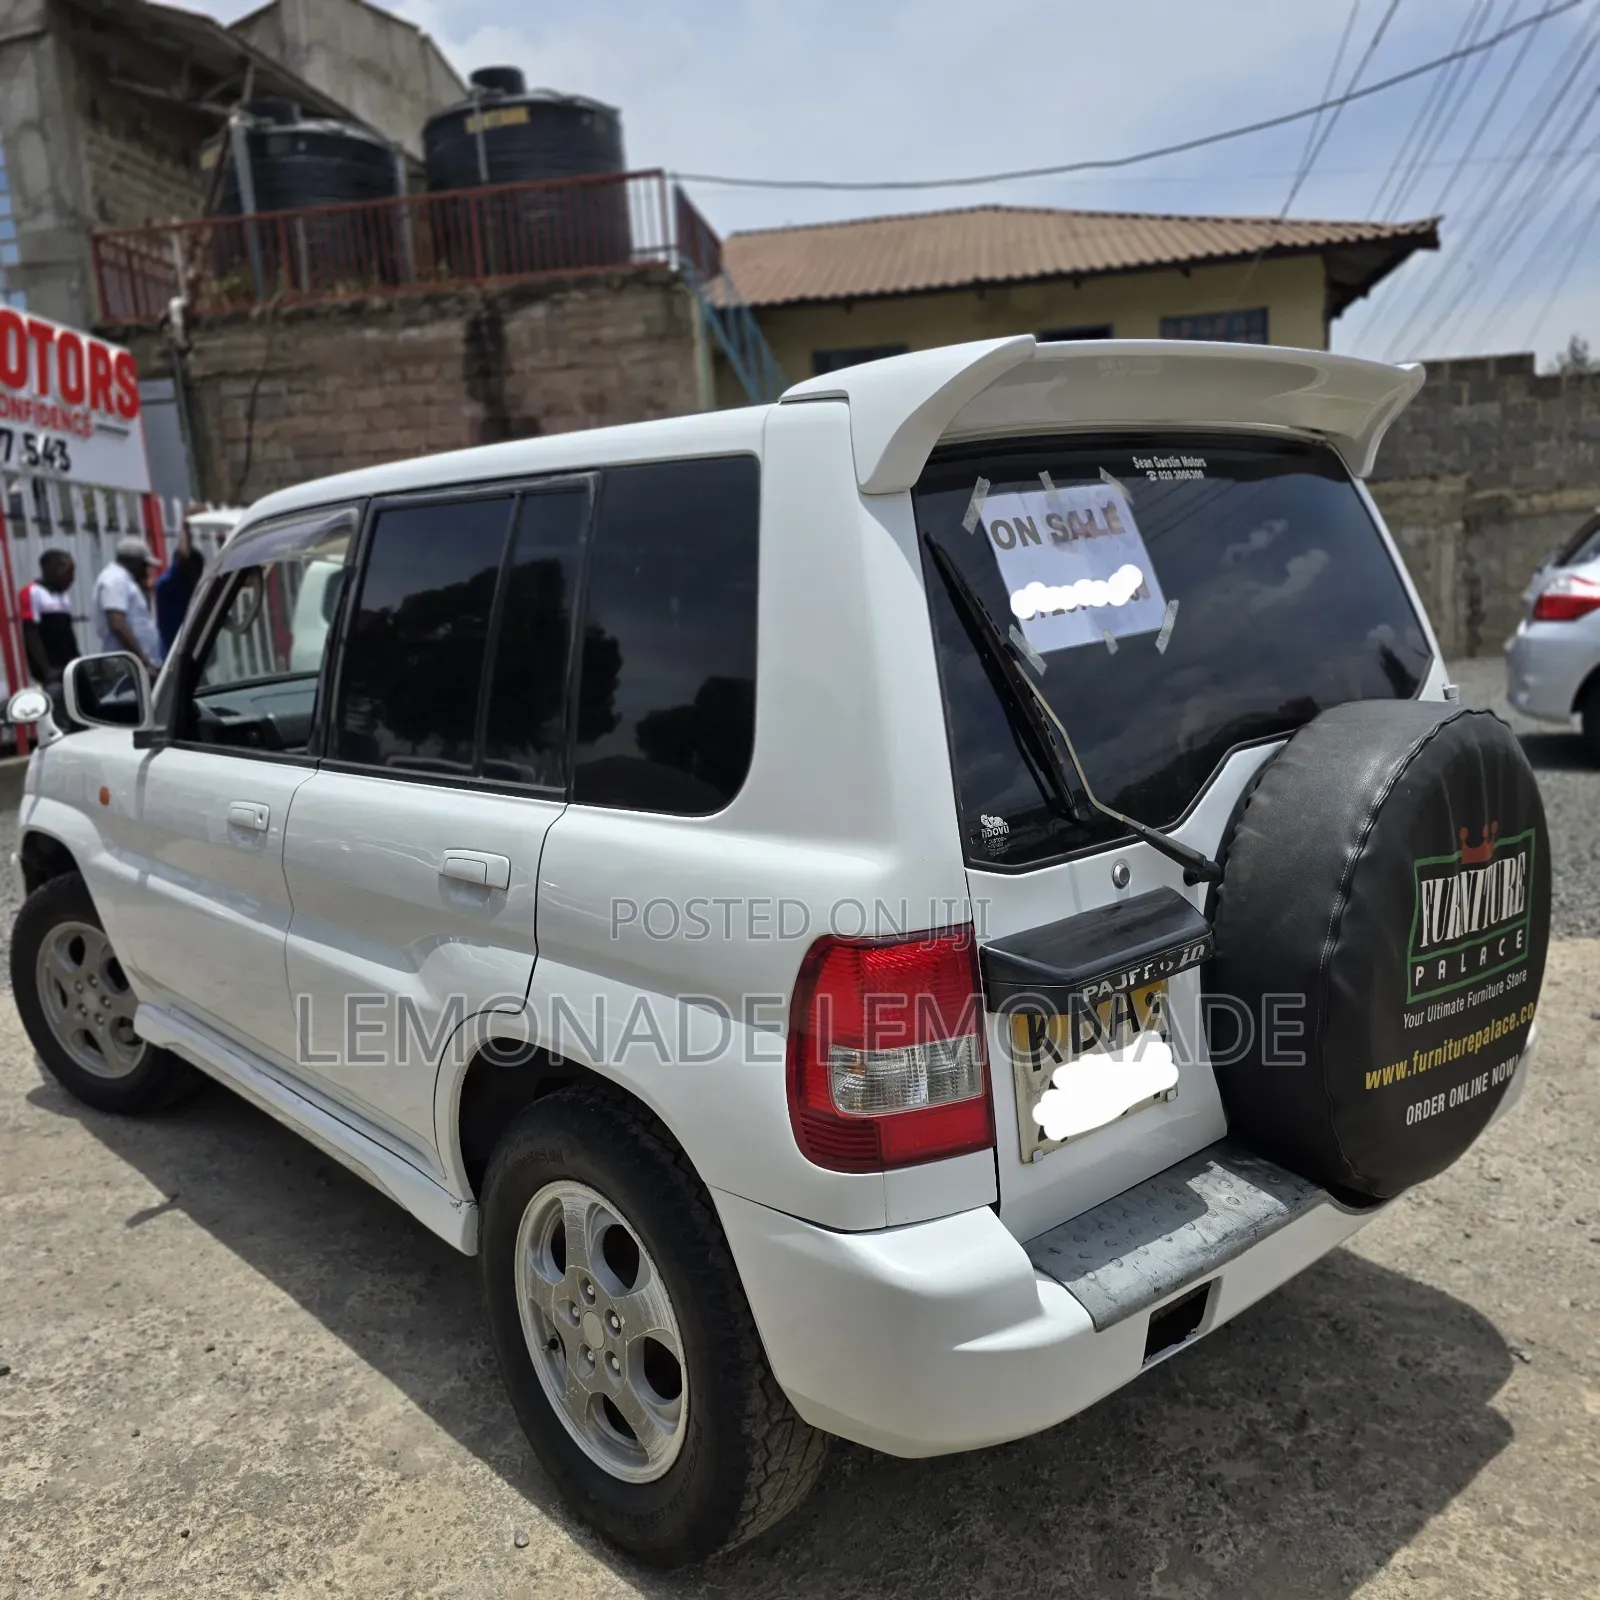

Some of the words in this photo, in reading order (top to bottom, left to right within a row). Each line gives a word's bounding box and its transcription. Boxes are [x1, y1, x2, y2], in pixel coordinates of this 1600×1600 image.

[23, 432, 71, 473] 543
[1132, 456, 1154, 469] Sean
[1181, 455, 1207, 468] Motors
[1158, 469, 1173, 480] 020
[990, 516, 1042, 550] ON
[1046, 500, 1126, 544] SALE
[1420, 851, 1527, 948] FURNITURE
[1415, 929, 1523, 986] PALACE
[1403, 1009, 1425, 1030] Your
[1427, 998, 1465, 1024] Ultimate
[1467, 982, 1504, 1009] Furniture
[1506, 969, 1527, 991] Store
[1365, 1001, 1535, 1090] www.furniturepalace.co
[1406, 1092, 1445, 1126] ORDER
[1449, 1071, 1489, 1109] ONLINE
[1492, 1054, 1519, 1087] NOW!
